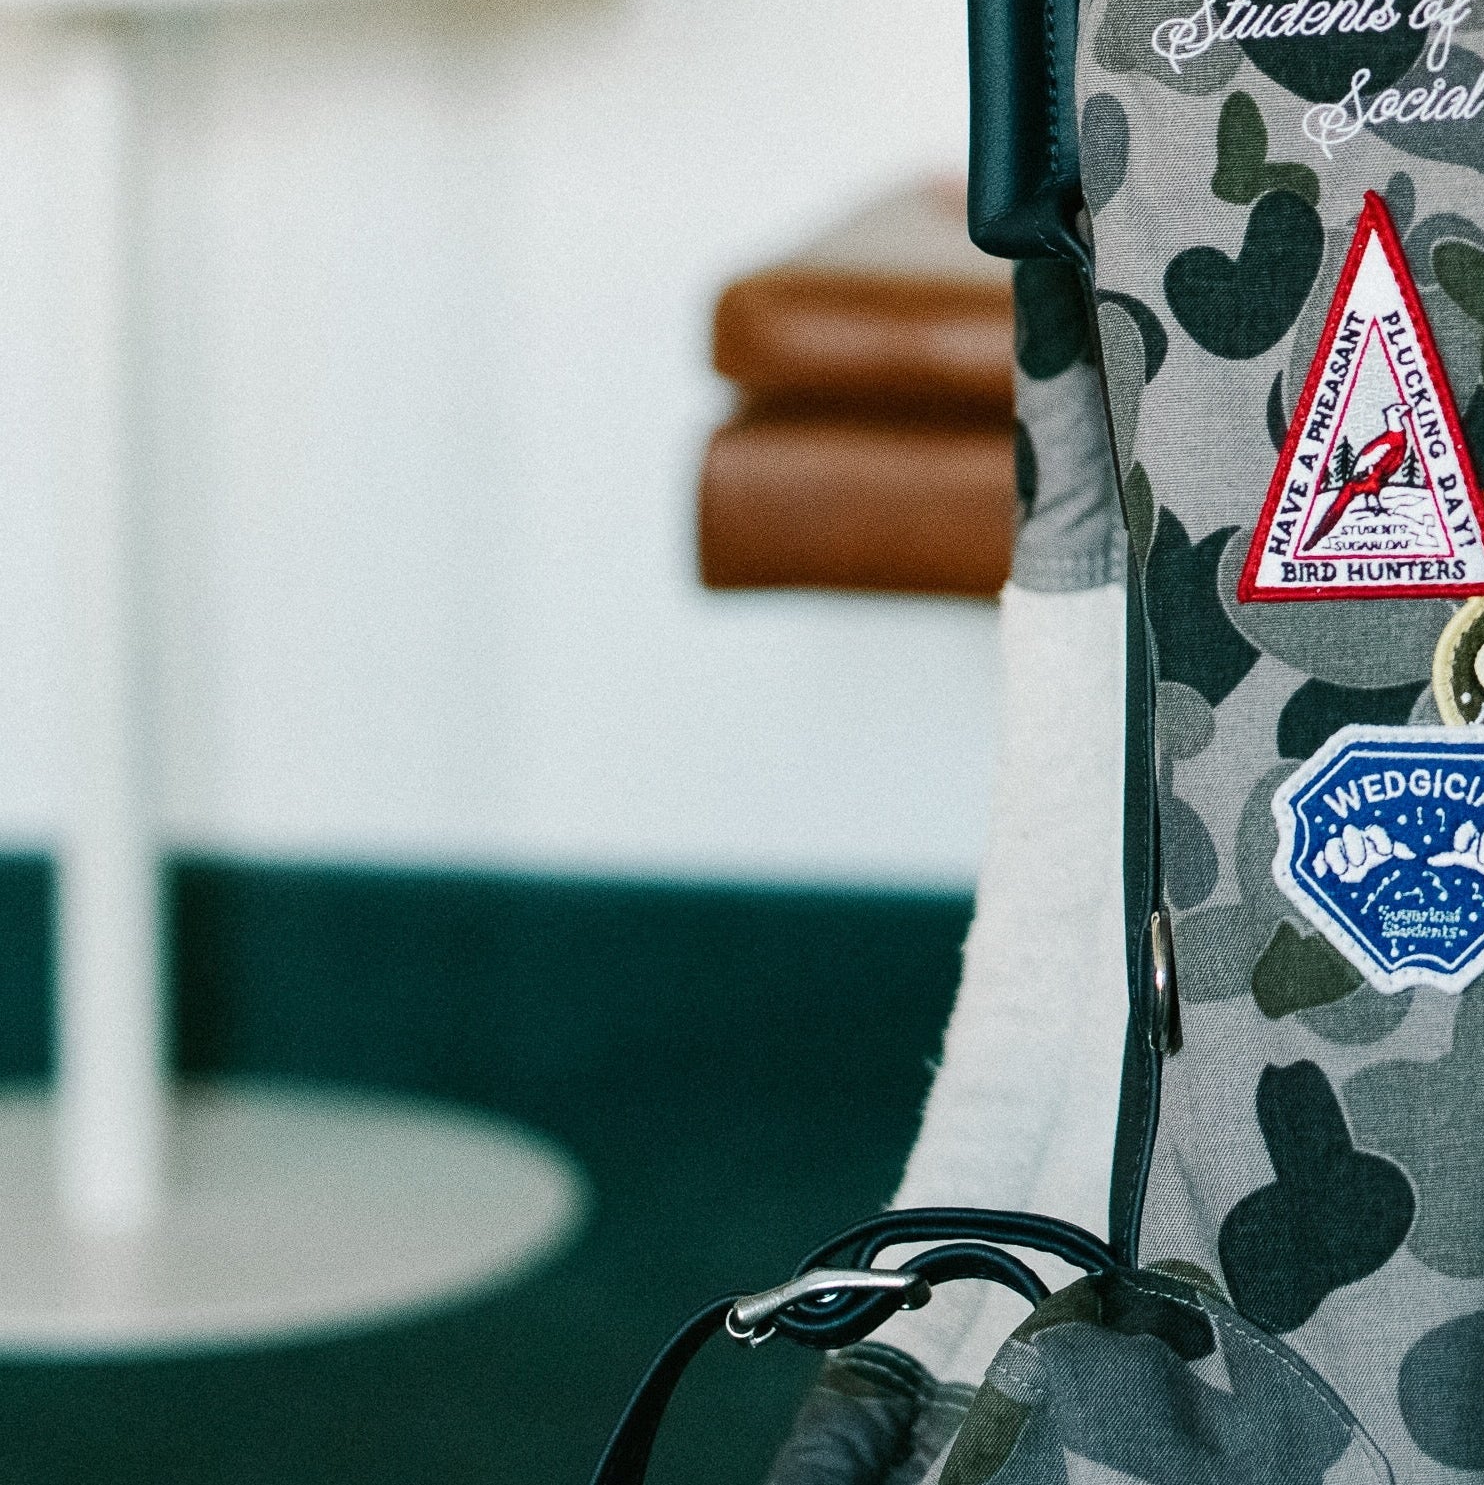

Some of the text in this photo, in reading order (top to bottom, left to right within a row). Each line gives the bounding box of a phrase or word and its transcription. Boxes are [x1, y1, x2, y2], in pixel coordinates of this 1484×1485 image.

[1268, 310, 1477, 556] HAVE A PHEASANT PLUCKING DAY!
[1281, 559, 1466, 584] BIRD HUNTERS
